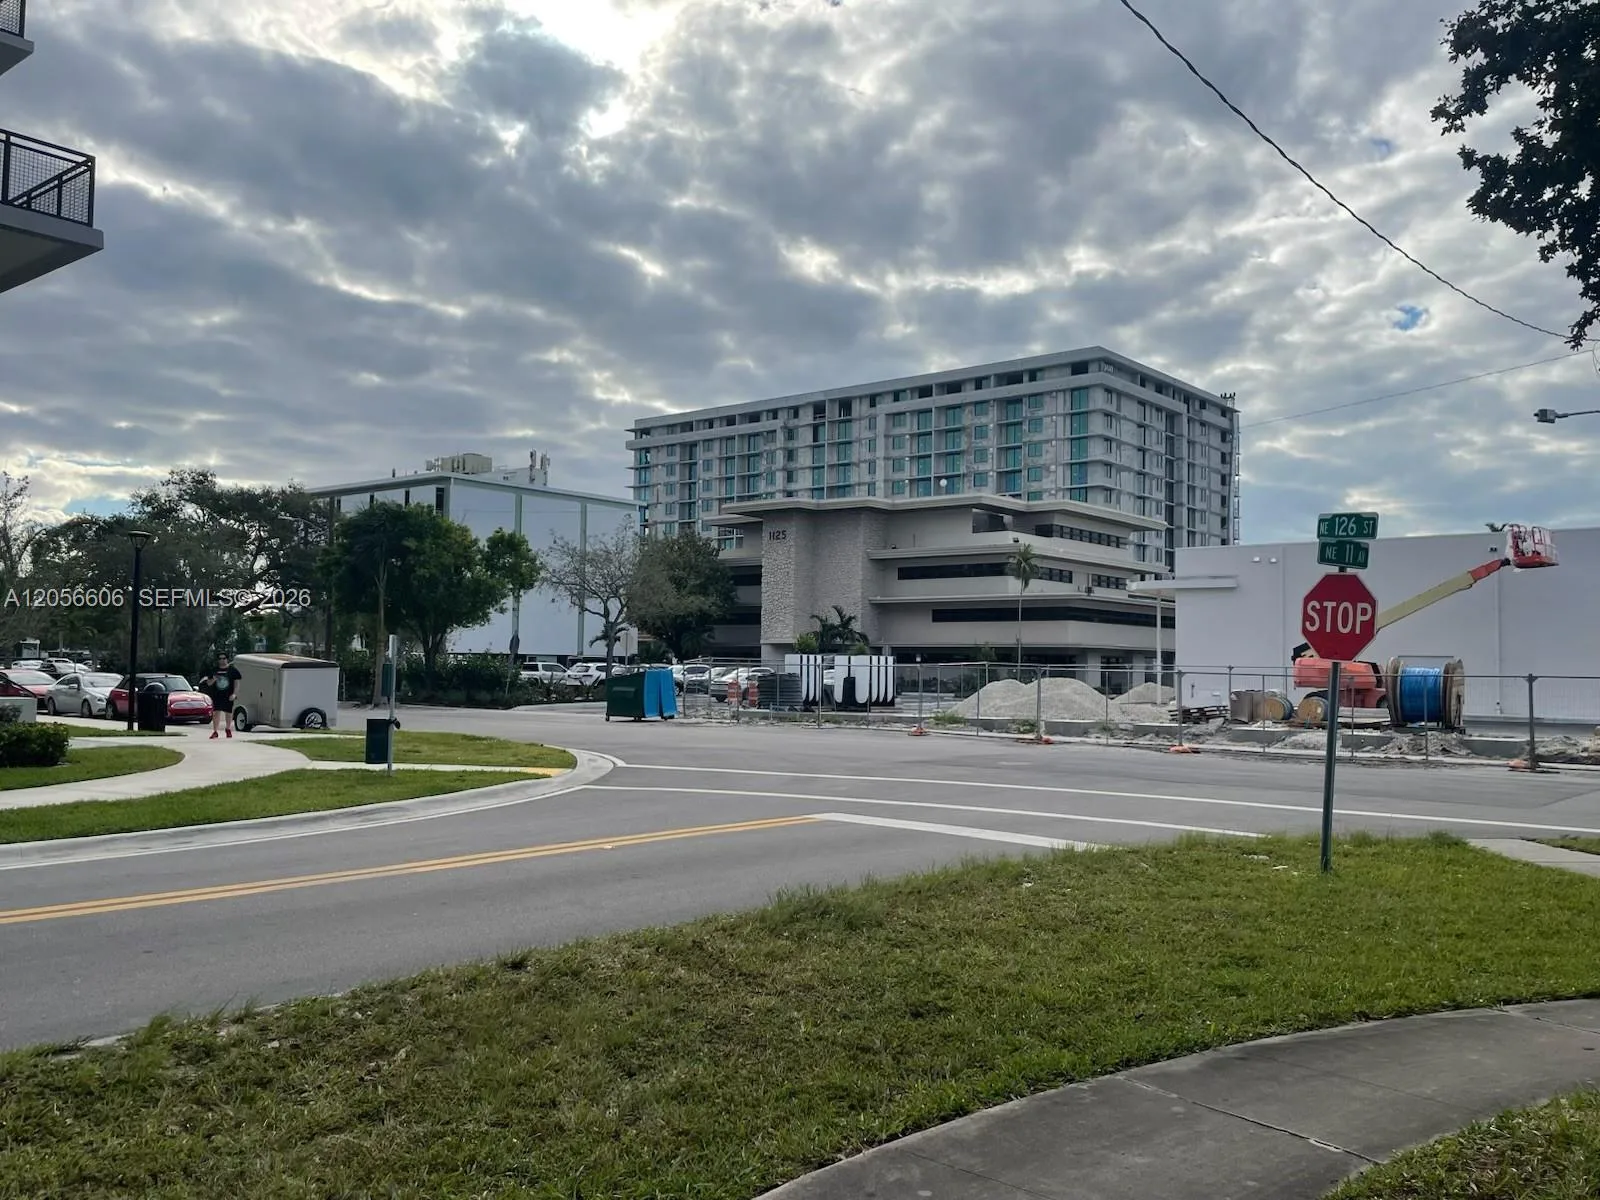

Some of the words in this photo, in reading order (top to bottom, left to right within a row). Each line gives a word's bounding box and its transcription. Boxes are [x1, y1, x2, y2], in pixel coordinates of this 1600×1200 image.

[769, 530, 787, 540] 1125
[1320, 521, 1328, 535] NE
[1335, 517, 1357, 536] 126
[1363, 520, 1374, 534] ST
[1325, 545, 1337, 560] NE
[1345, 543, 1354, 563] 11
[1305, 600, 1372, 635] STOP
